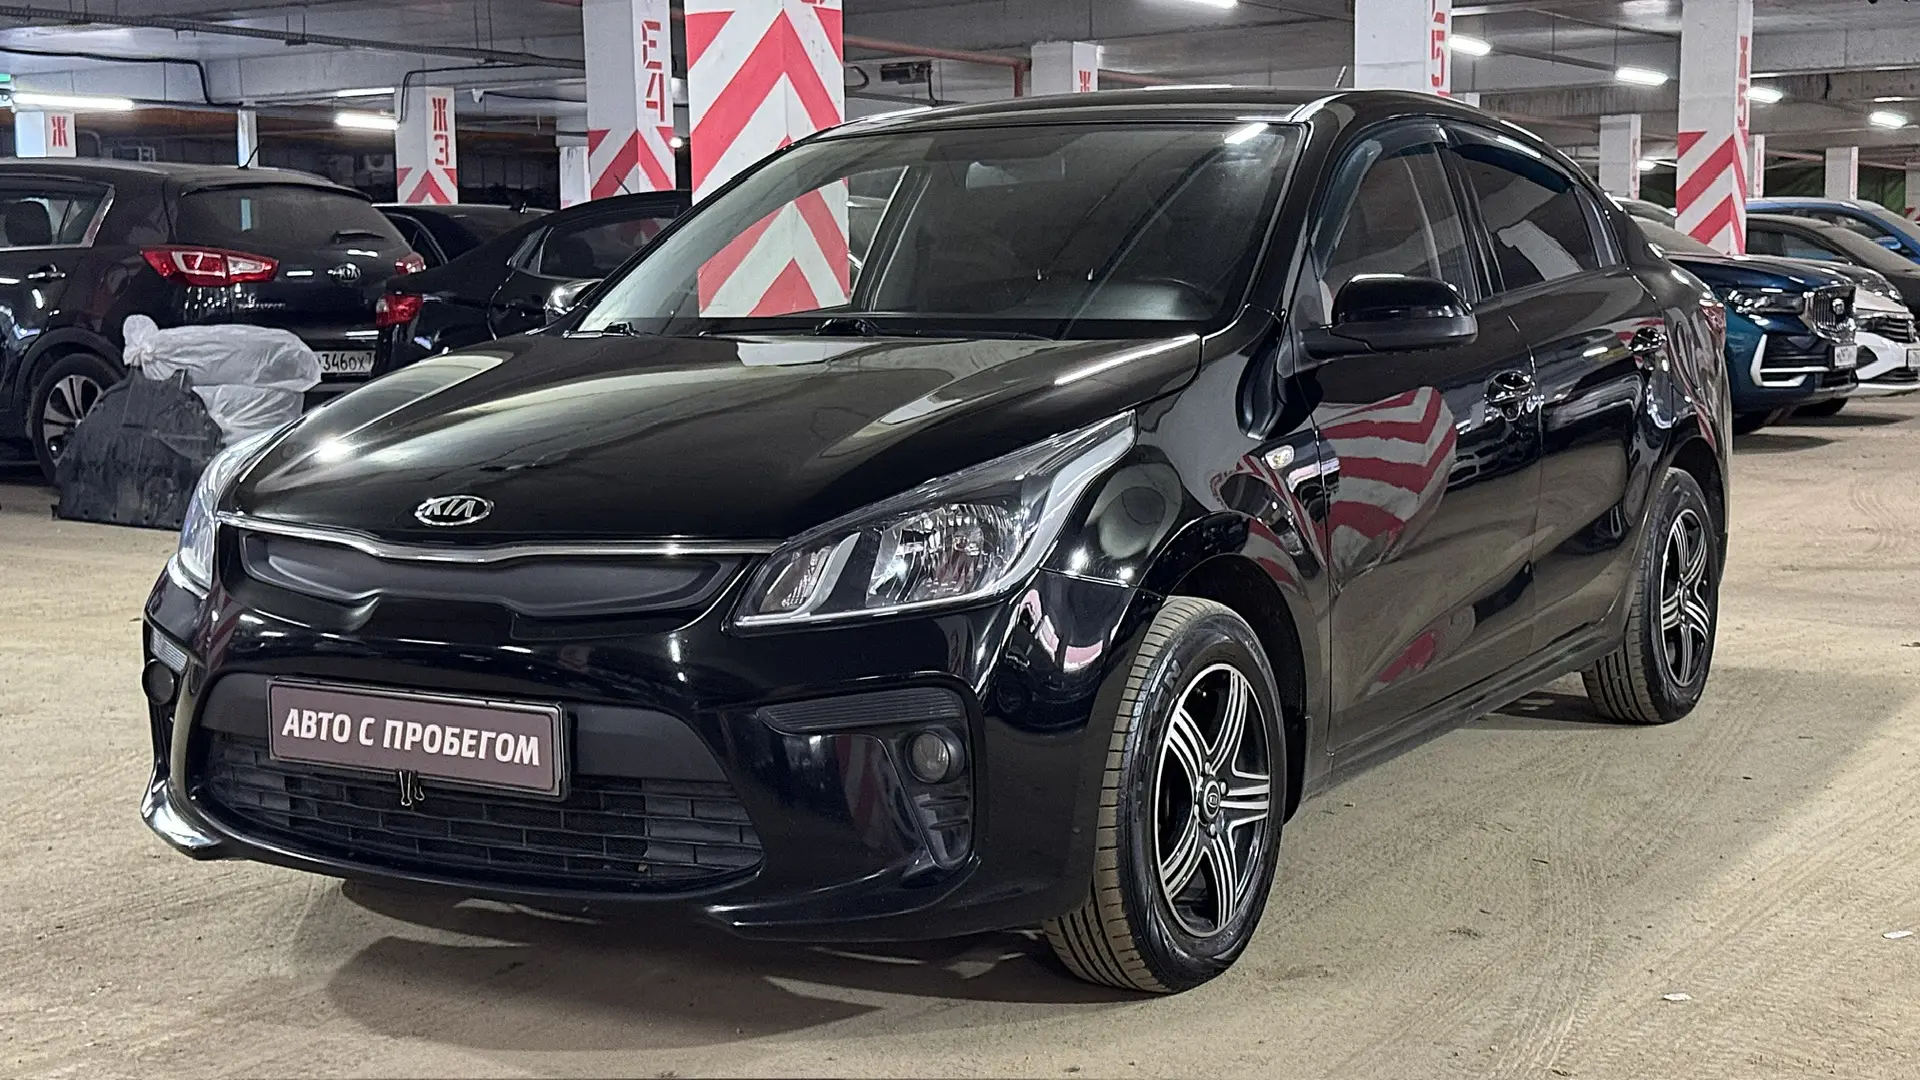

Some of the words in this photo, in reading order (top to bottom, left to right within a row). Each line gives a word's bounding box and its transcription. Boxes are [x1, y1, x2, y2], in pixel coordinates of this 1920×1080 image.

[51, 115, 69, 147] Ж
[317, 352, 365, 371] 346ОХ
[423, 497, 478, 518] KIA
[281, 708, 351, 743] АВТО
[358, 716, 376, 747] С
[382, 719, 540, 767] ПРОБЕГОМ
